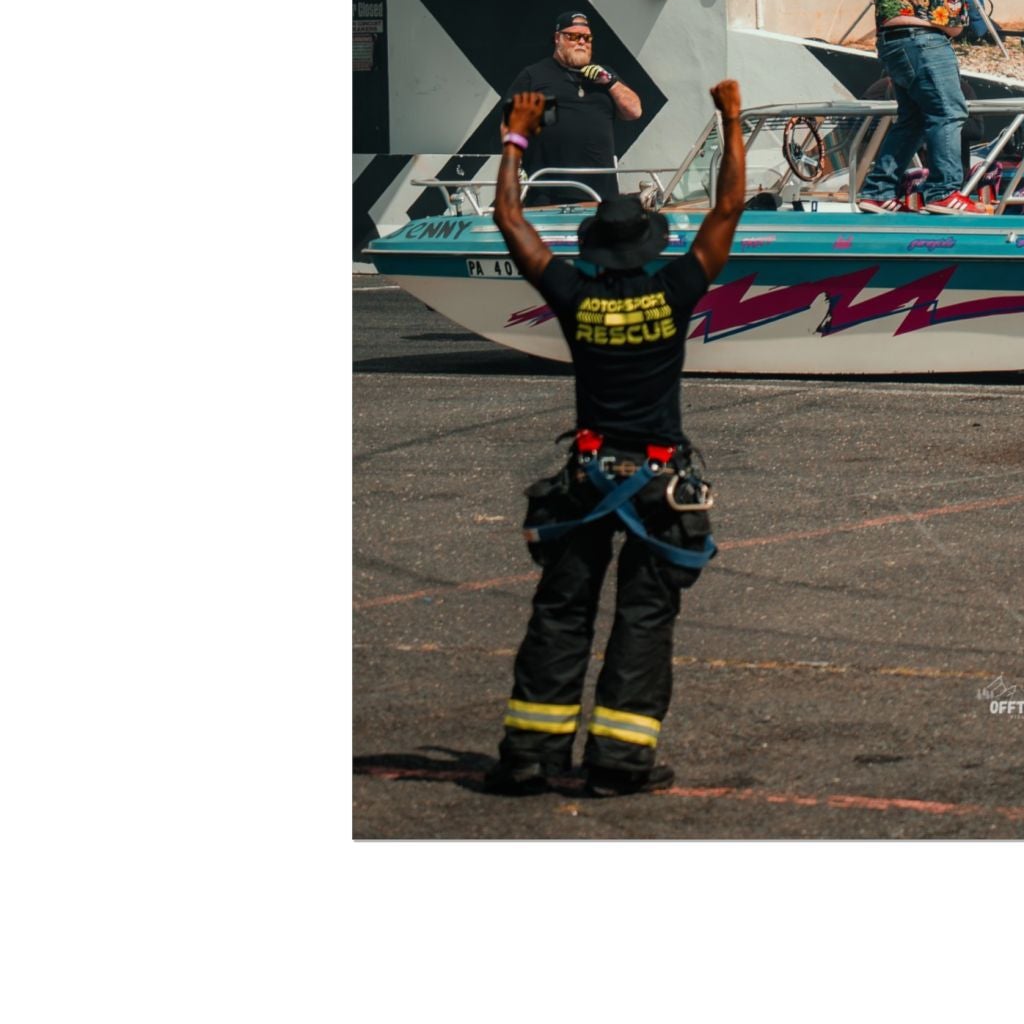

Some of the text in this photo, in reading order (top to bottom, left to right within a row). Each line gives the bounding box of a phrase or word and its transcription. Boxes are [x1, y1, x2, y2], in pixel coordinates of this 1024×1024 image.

[468, 260, 521, 276] PA 40
[579, 291, 665, 313] MOTORSPORT
[575, 317, 678, 345] RESCUE
